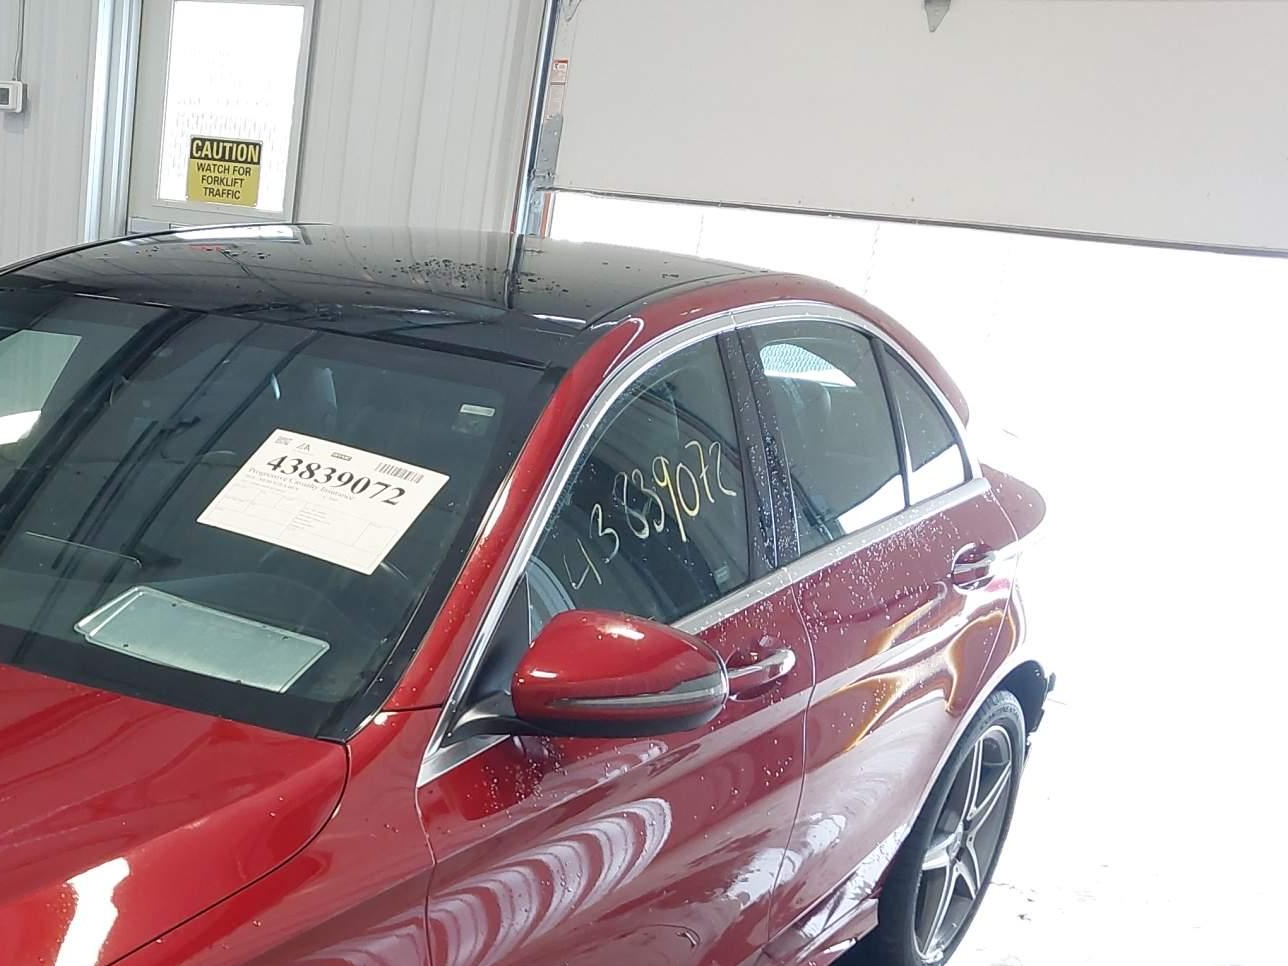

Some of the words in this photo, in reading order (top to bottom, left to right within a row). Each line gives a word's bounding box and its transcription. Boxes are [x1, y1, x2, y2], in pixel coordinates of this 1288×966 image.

[192, 140, 260, 163] CAUTION
[196, 162, 230, 175] WATCH
[232, 165, 252, 177] FOR
[201, 175, 245, 188] FORKLIFT
[203, 187, 241, 200] TRAFFIC
[266, 455, 406, 506] 43839072
[563, 440, 737, 590] 43839072
